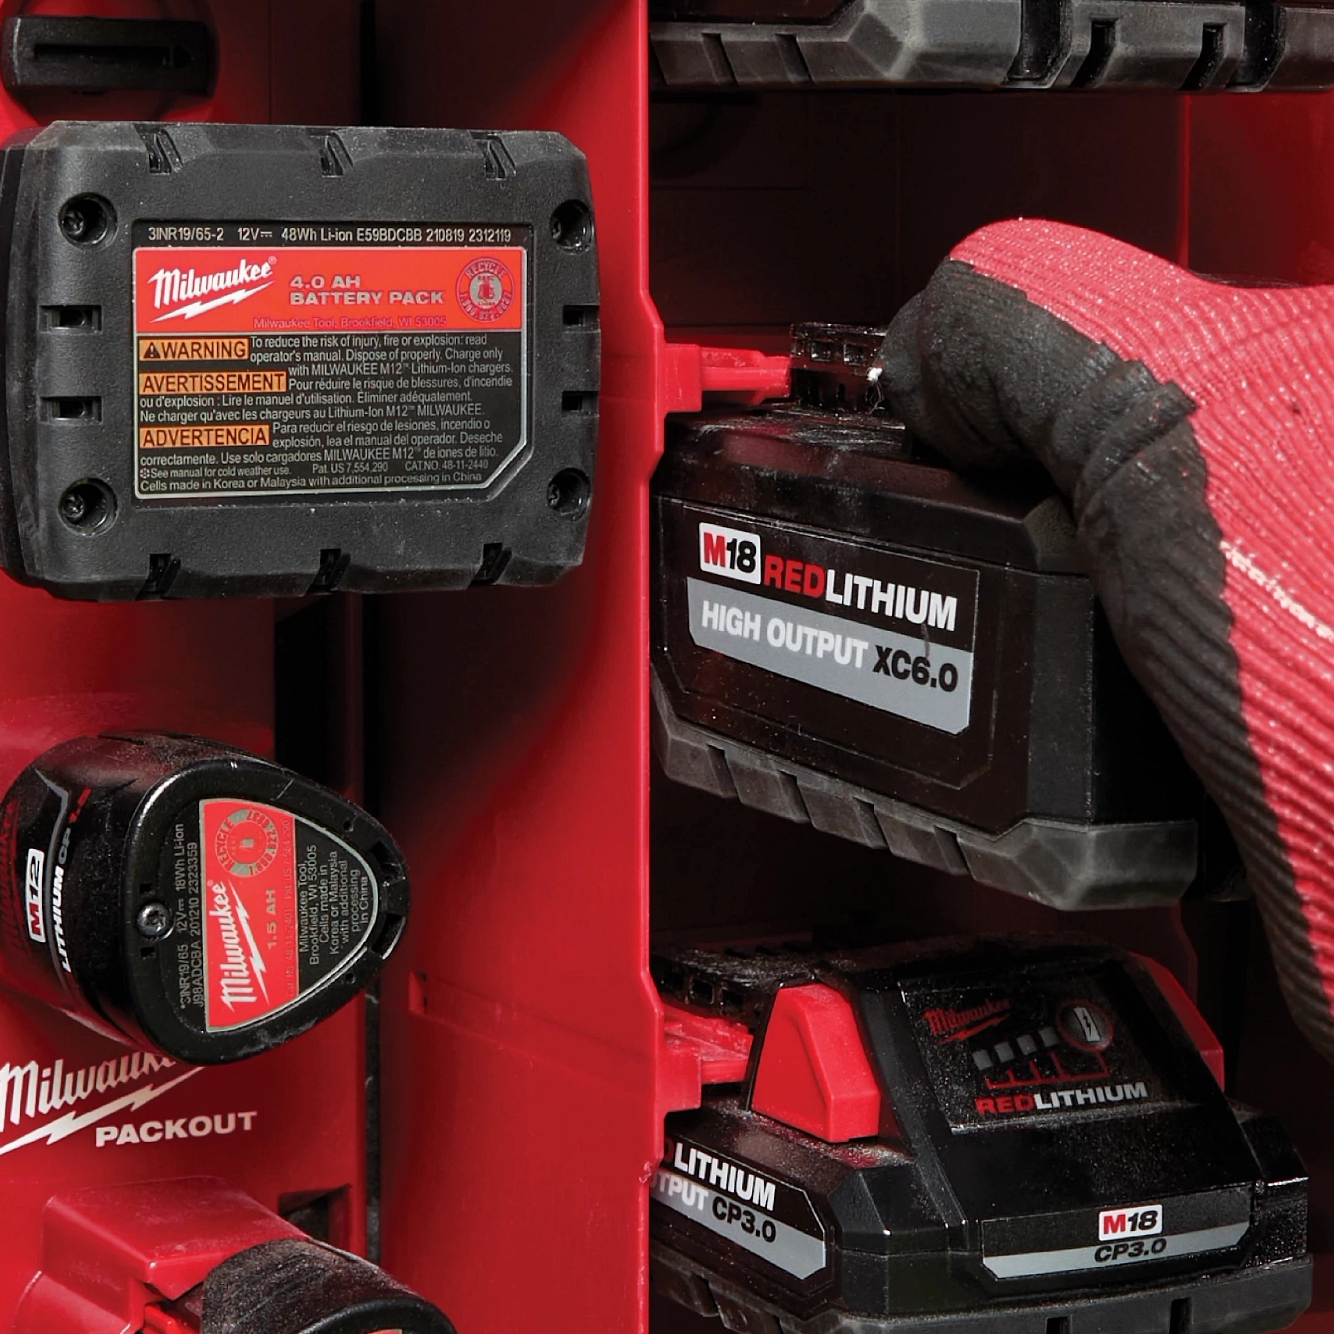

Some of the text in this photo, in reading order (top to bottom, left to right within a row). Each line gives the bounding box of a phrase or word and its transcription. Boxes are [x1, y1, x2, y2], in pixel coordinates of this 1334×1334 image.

[149, 228, 223, 241] 3INR19/65-2
[281, 228, 316, 241] 48Wh
[321, 228, 353, 241] Li-ion
[357, 228, 422, 242] E59BDCBB
[426, 229, 464, 242] 210819
[469, 229, 511, 242] 2312119
[147, 259, 273, 309] Milwaukee
[290, 276, 360, 288] 4.0 AH
[290, 291, 445, 304] BATTERY PACK
[253, 317, 310, 329] Milwaukee
[162, 341, 245, 358] WARNING
[251, 334, 486, 348] To reduce the risk of injury, fire or explosion: read
[250, 349, 502, 364] operator's manual. Dispose of properly. Charge only
[289, 366, 309, 376] with
[312, 364, 377, 375] MILWAUKEE
[468, 361, 513, 376] chargers.
[143, 374, 284, 392] AVERTISSEMENT
[289, 376, 512, 391] Pour réduire le risque de blessures, d'incendie
[140, 397, 153, 407] ou
[156, 396, 214, 409] d'explosion
[223, 395, 241, 406] Lire
[244, 395, 253, 405] le
[256, 394, 293, 405] manuel
[296, 393, 353, 404] d'utilisation.
[400, 391, 472, 404] adéquatement.
[141, 411, 155, 422] Ne
[158, 411, 198, 424] charger
[200, 410, 240, 423] qu'avec
[243, 409, 257, 420] les
[260, 408, 310, 422] chargeurs
[314, 409, 326, 418] au
[418, 403, 485, 416] MILWAUKEE.
[143, 428, 266, 446] ADVERTENCIA
[273, 419, 490, 434] Para reducir el riesgo de lesiones, incendio o
[703, 532, 957, 631] M18 REDLITHIUM
[702, 600, 958, 692] HIGH OUTPUT XC6.0
[187, 842, 198, 895] 2323359
[29, 855, 42, 936] M12
[266, 889, 276, 913] AH
[307, 845, 319, 965] Brookfield, WI 53005
[189, 898, 201, 937] 201210
[208, 882, 257, 1012] Milwaukee
[974, 1082, 1148, 1114] REDLITHIUM
[95, 1111, 257, 1147] PACKOUT
[712, 1196, 776, 1242] CP3.0
[1103, 1210, 1158, 1234] M18
[1094, 1238, 1167, 1263] CP3.0
